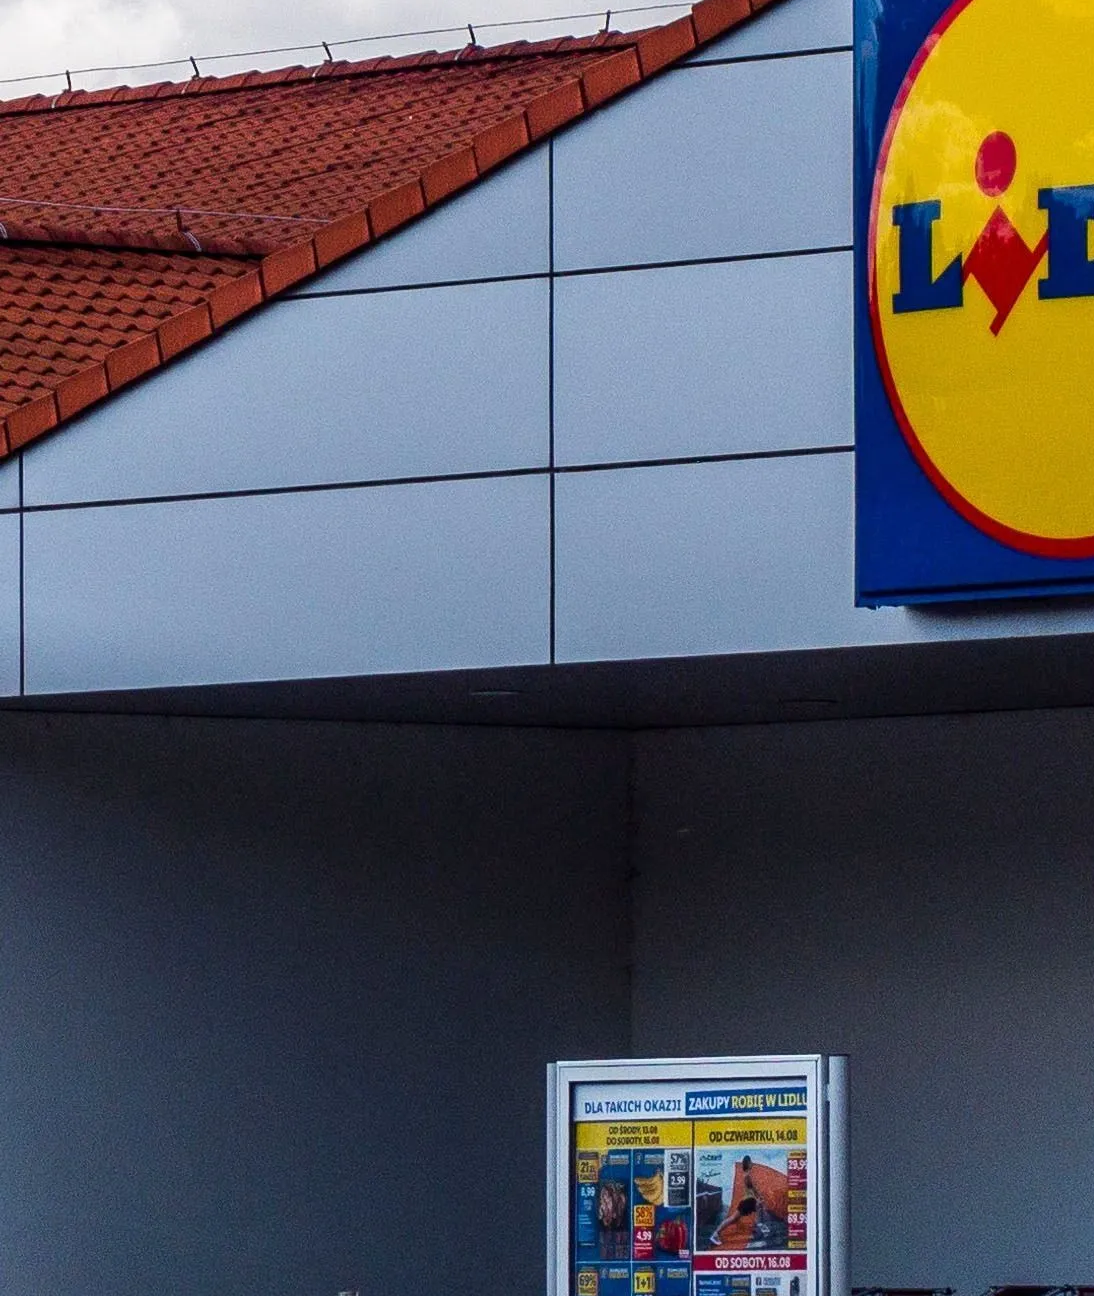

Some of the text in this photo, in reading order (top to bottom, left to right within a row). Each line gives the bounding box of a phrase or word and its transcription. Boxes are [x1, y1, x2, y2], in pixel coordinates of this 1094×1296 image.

[584, 1100, 603, 1114] DLA
[605, 1100, 641, 1114] TAKICH
[645, 1099, 681, 1112] OKAZJI
[688, 1095, 730, 1111] ZAKUPY
[731, 1094, 764, 1110] ROBIĘ
[766, 1093, 777, 1106] W
[606, 1136, 617, 1145] DO
[709, 1129, 798, 1144] OD CZWARTKU, 14.08
[715, 1256, 791, 1269] OD SOBOTY, 16.08
